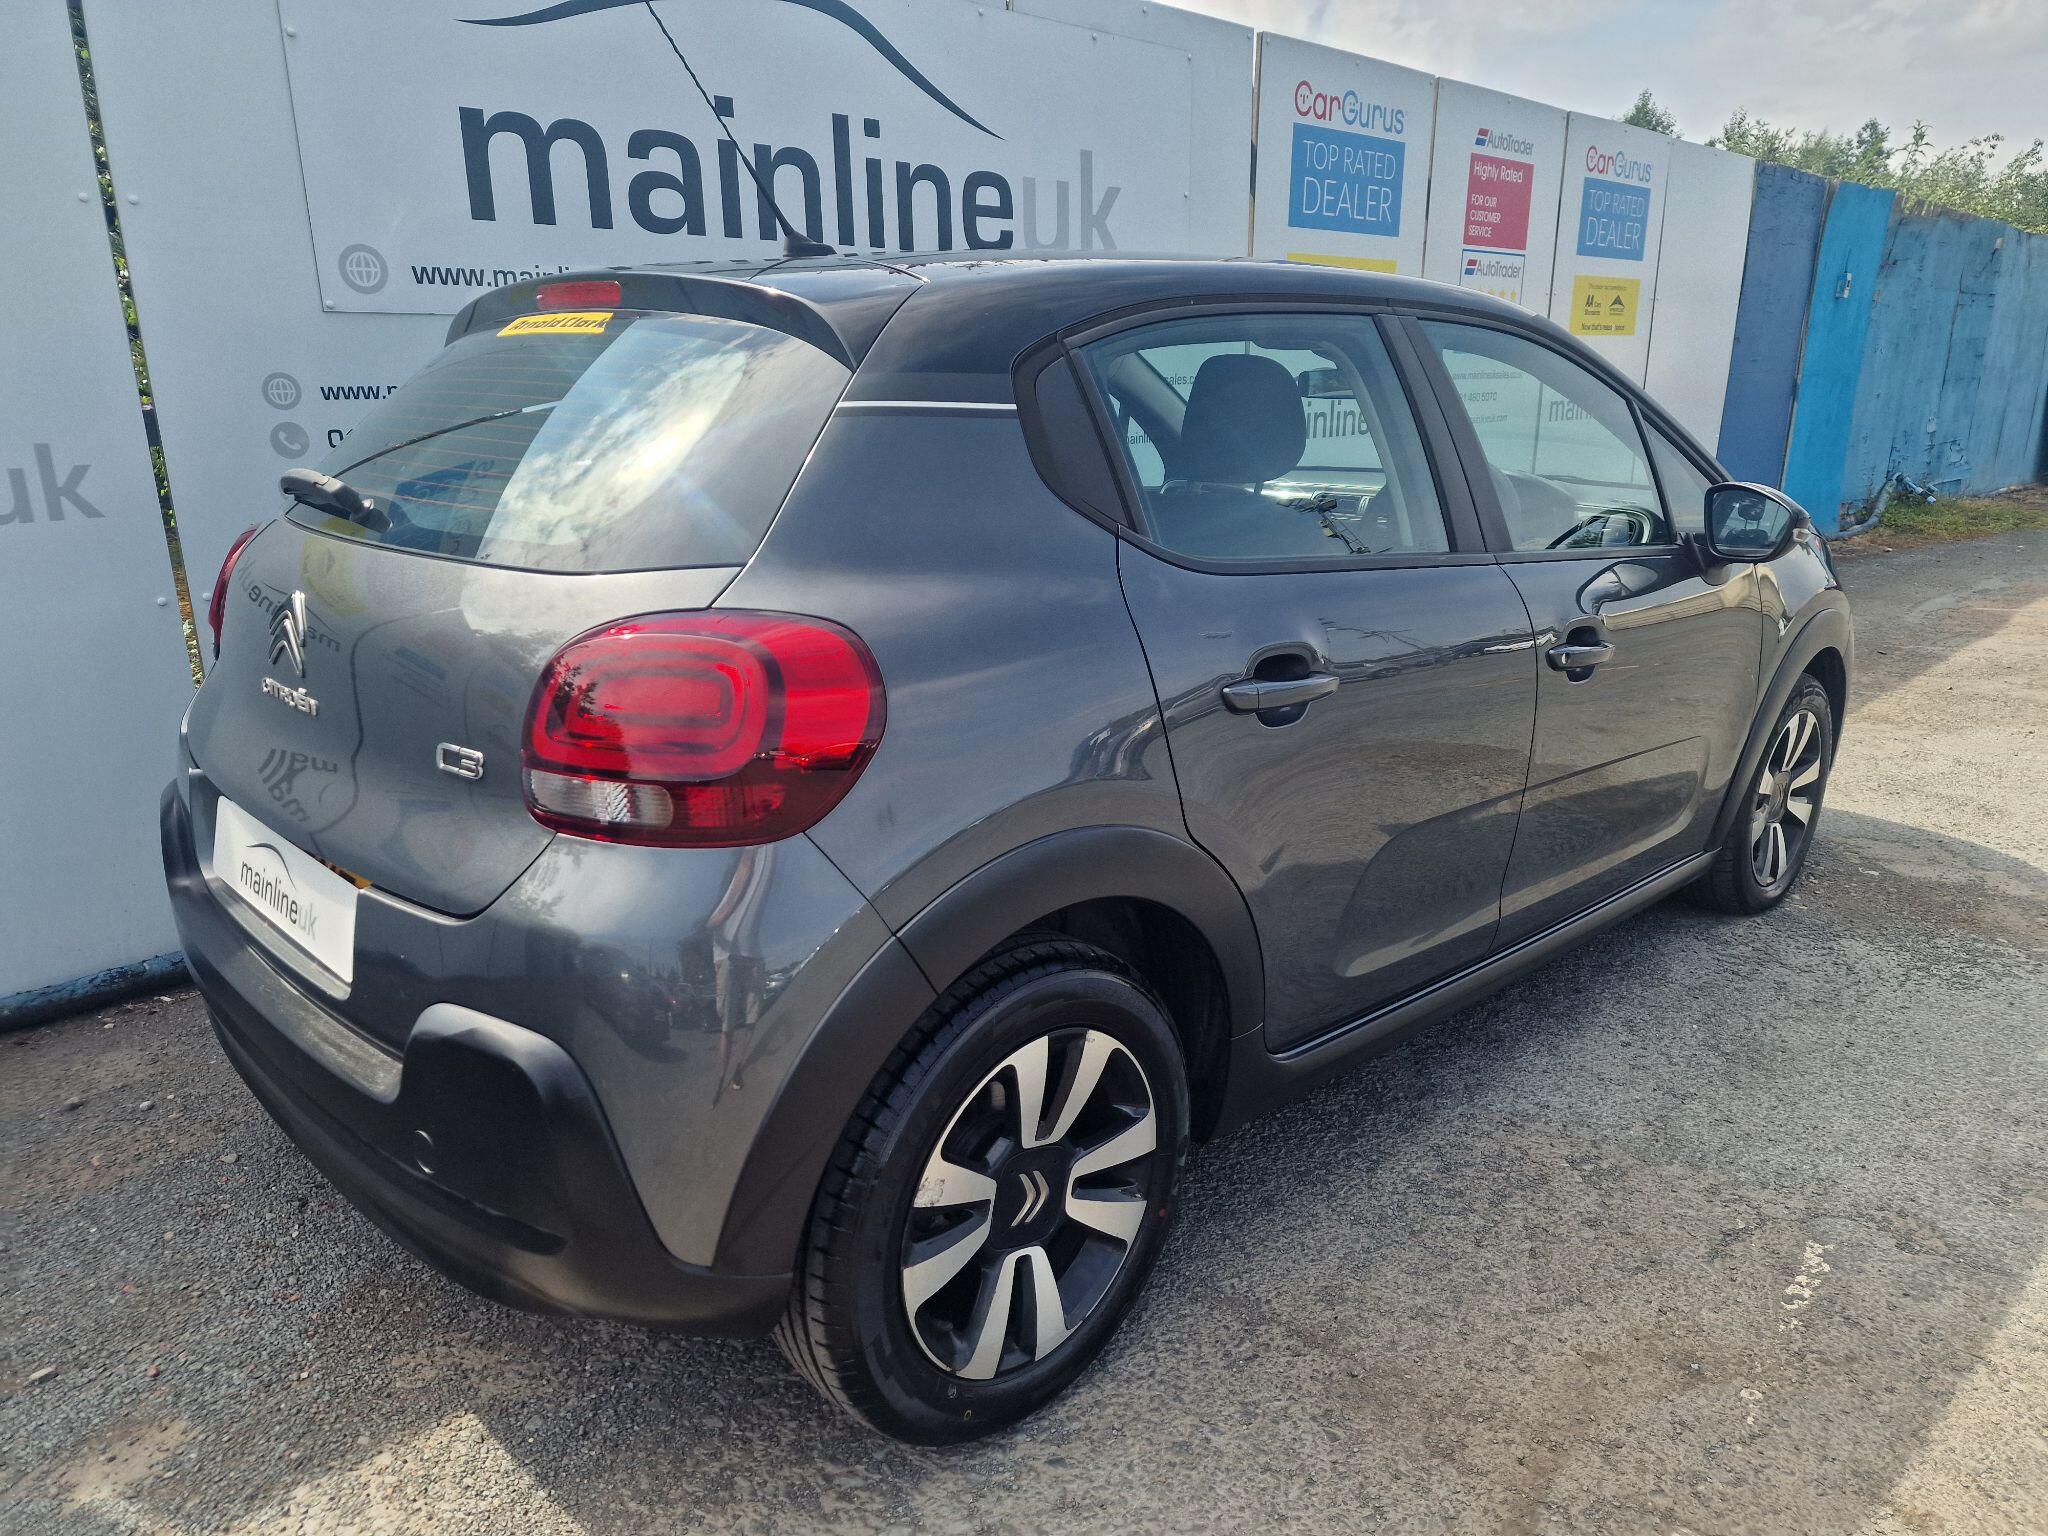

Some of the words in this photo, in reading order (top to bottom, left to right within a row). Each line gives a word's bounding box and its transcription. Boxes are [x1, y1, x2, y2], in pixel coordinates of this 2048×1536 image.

[1294, 80, 1404, 134] CarGurus
[1487, 130, 1535, 155] AutoTrader
[459, 94, 1122, 251] mainlineuk
[1303, 140, 1339, 171] TOP
[1343, 147, 1397, 180] RATED
[1473, 161, 1499, 182] Highly
[1500, 166, 1524, 182] Rated
[1586, 145, 1652, 182] CarGurus
[1302, 176, 1393, 222] DEALER
[1471, 194, 1484, 206] FOR
[1484, 196, 1497, 207] OUR
[1589, 189, 1612, 213] TOP
[1612, 194, 1645, 218] RATED
[1468, 225, 1492, 237] SERVICE
[1470, 210, 1501, 223] CUSTOMER
[1586, 216, 1640, 249] DEALER
[1476, 260, 1521, 278] AutoTrader
[509, 317, 566, 331] Arnold
[436, 742, 484, 780] C3
[241, 860, 319, 940] mainlineuk
